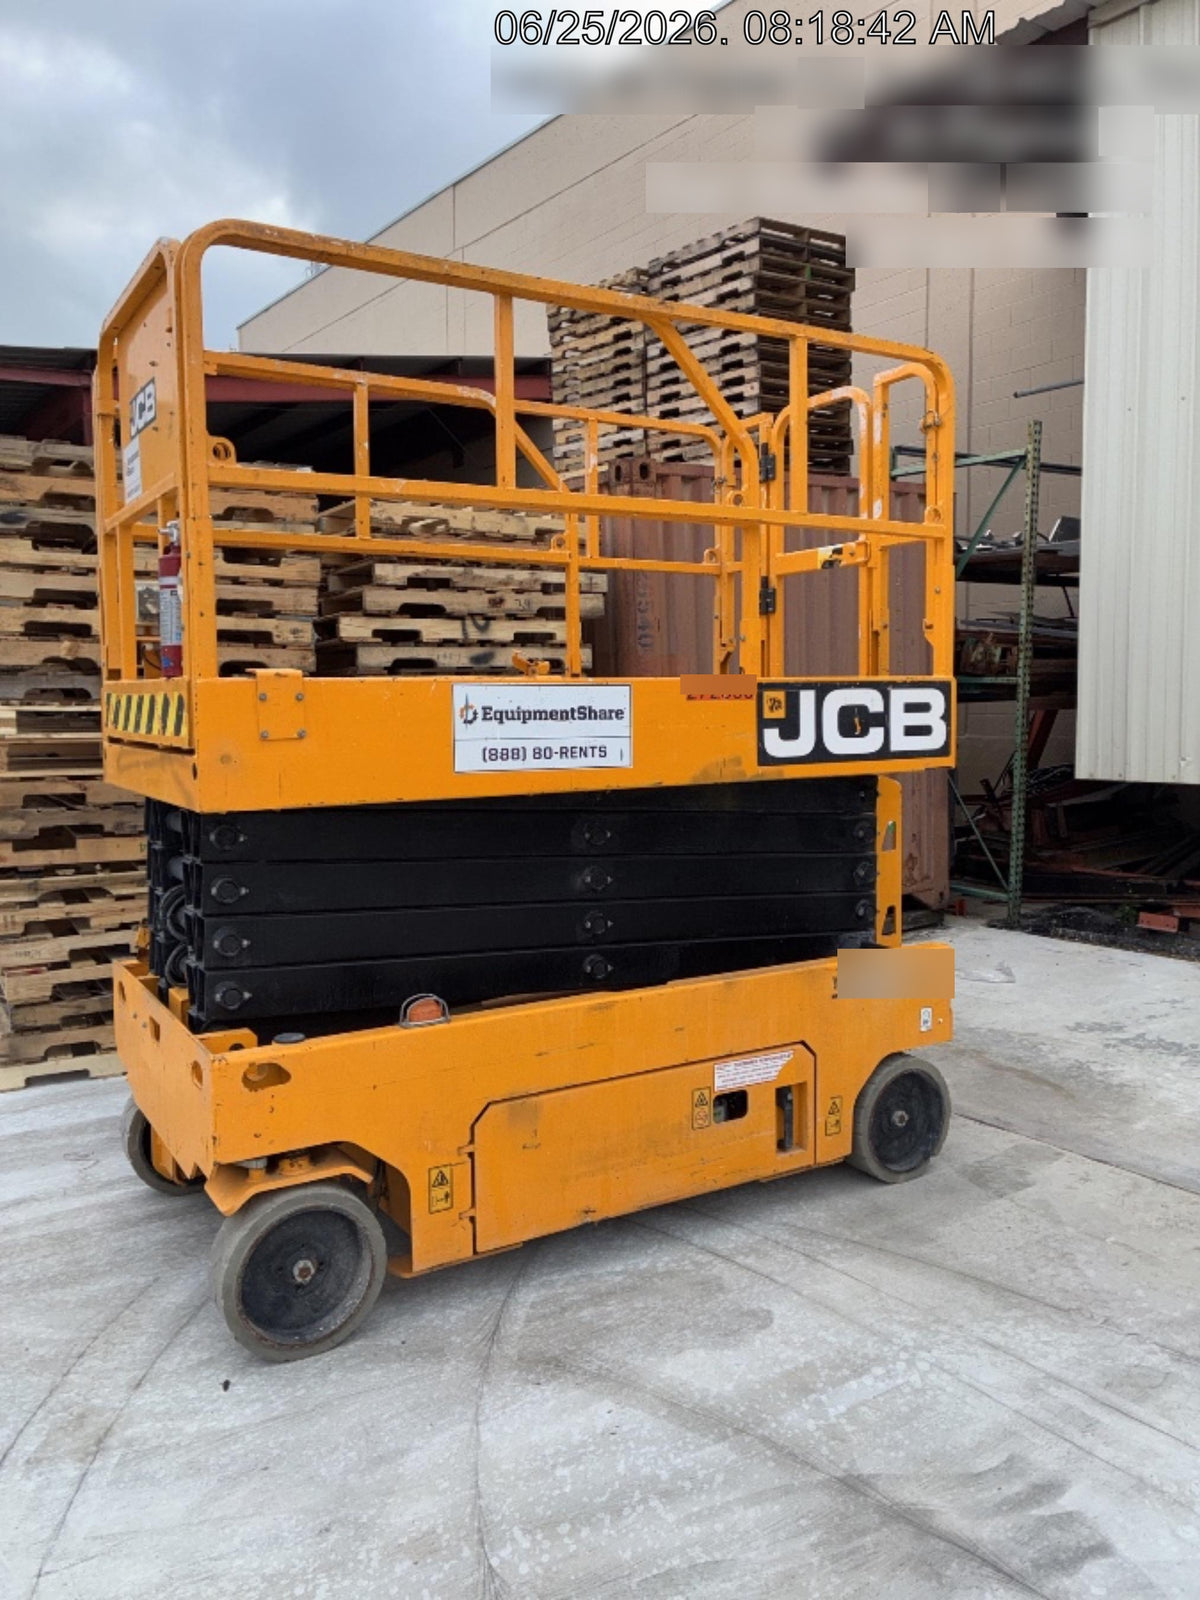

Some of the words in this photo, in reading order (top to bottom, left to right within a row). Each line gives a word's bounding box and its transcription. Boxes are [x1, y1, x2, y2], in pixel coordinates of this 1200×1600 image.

[481, 705, 625, 724] EquipmentShare
[763, 687, 947, 758] JCB
[481, 746, 527, 763] (888)
[532, 746, 608, 760] 80-RENTS
